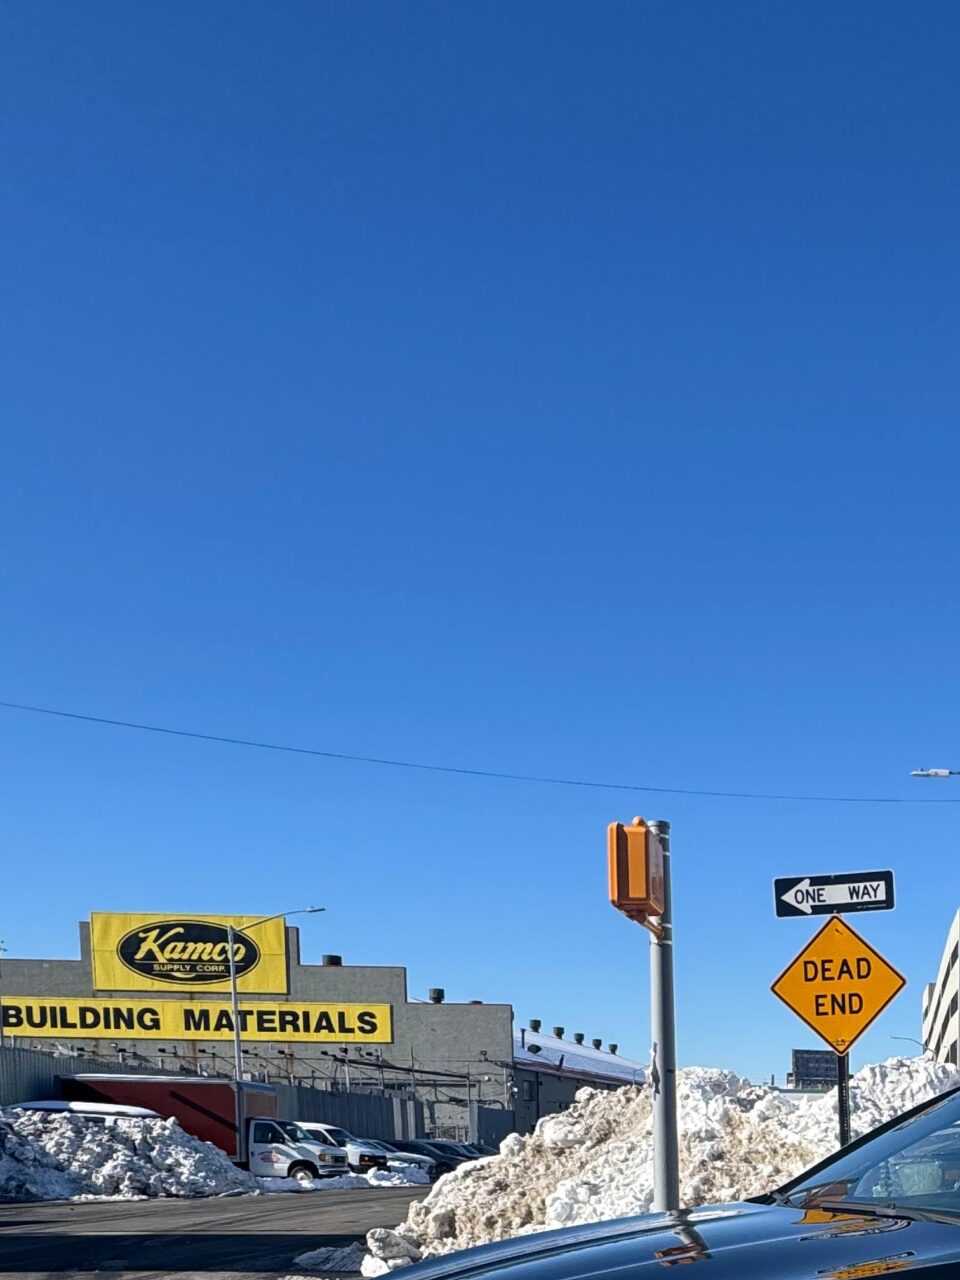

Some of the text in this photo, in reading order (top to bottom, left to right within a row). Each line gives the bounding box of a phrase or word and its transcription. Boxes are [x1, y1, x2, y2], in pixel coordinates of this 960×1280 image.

[794, 883, 881, 905] ONE WAY
[134, 927, 246, 963] Kamco
[153, 963, 226, 973] SUPPLY CORP.
[803, 957, 872, 982] DEAD
[815, 992, 864, 1017] END
[2, 1005, 378, 1035] BUILDING MATERIALS
